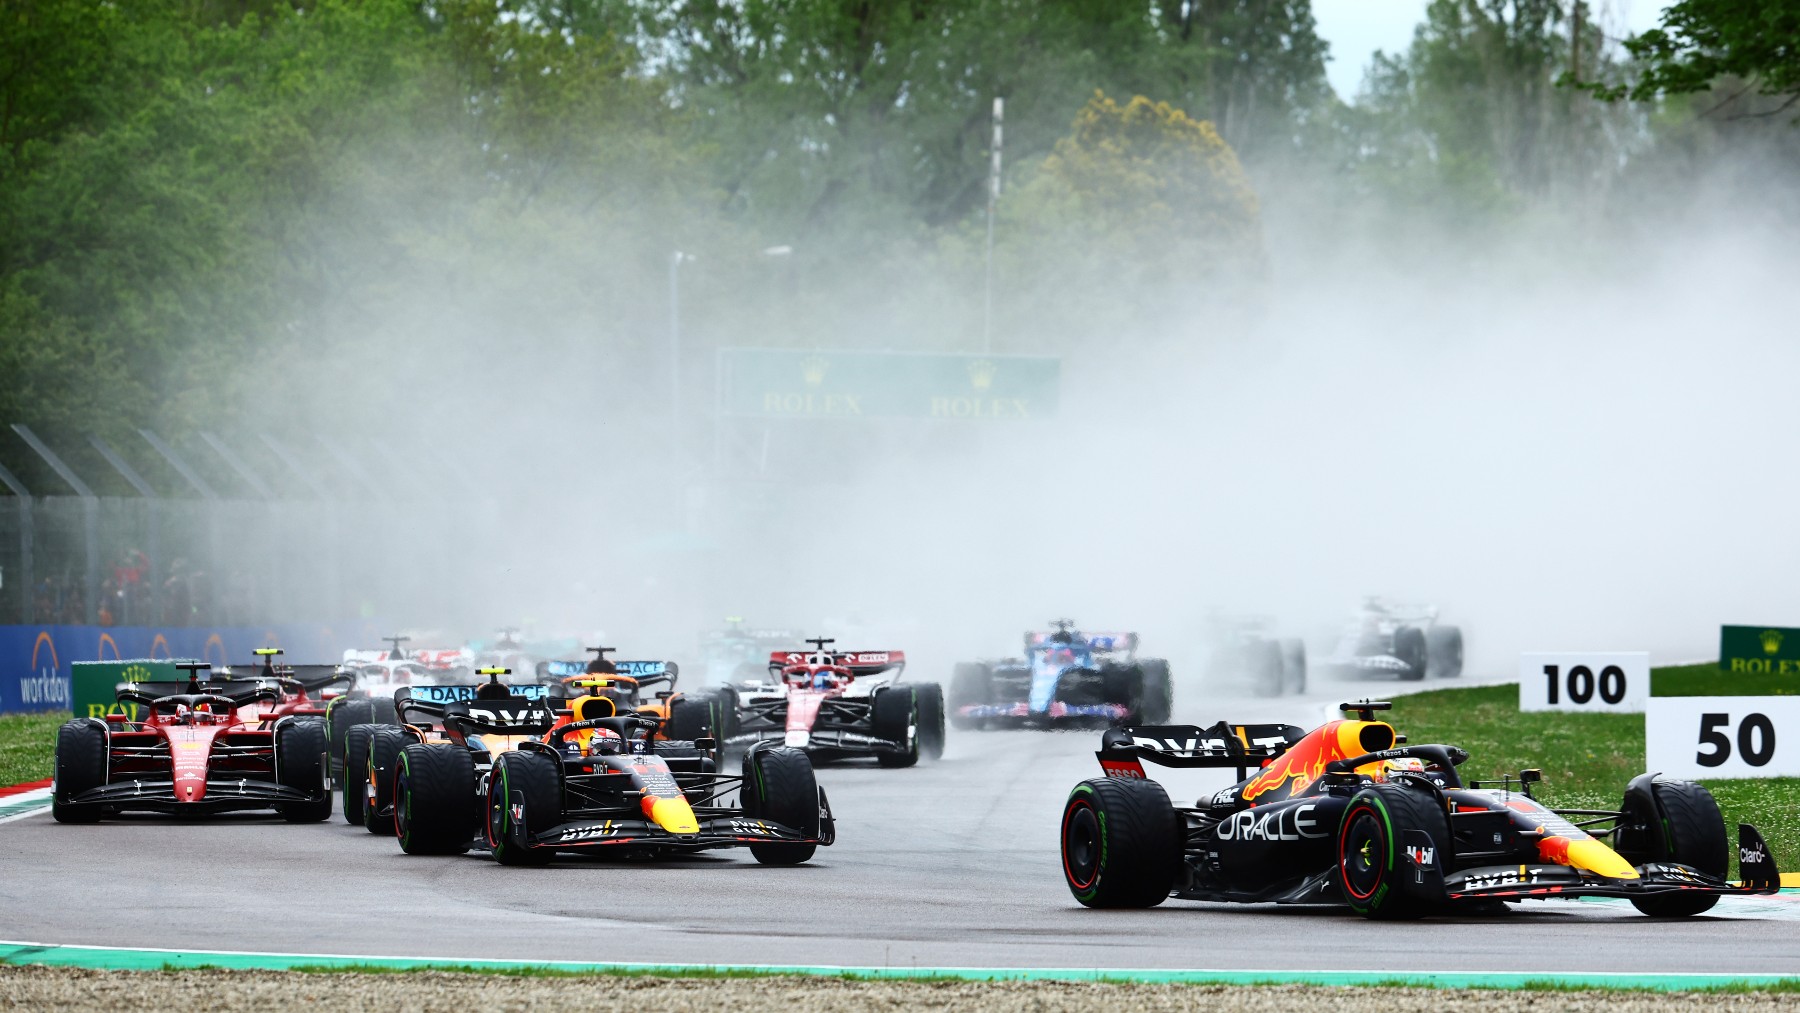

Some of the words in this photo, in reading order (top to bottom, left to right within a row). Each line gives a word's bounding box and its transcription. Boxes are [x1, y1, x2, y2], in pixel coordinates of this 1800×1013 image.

[763, 392, 862, 415] ROLEX
[930, 396, 1029, 418] ROLEX
[1731, 657, 1800, 675] ROLE
[20, 666, 70, 709] workday
[1543, 665, 1626, 705] 100
[1696, 713, 1776, 767] 50
[1216, 804, 1329, 841] ORACLE
[1407, 846, 1434, 864] Mobil
[1740, 847, 1763, 863] Claro
